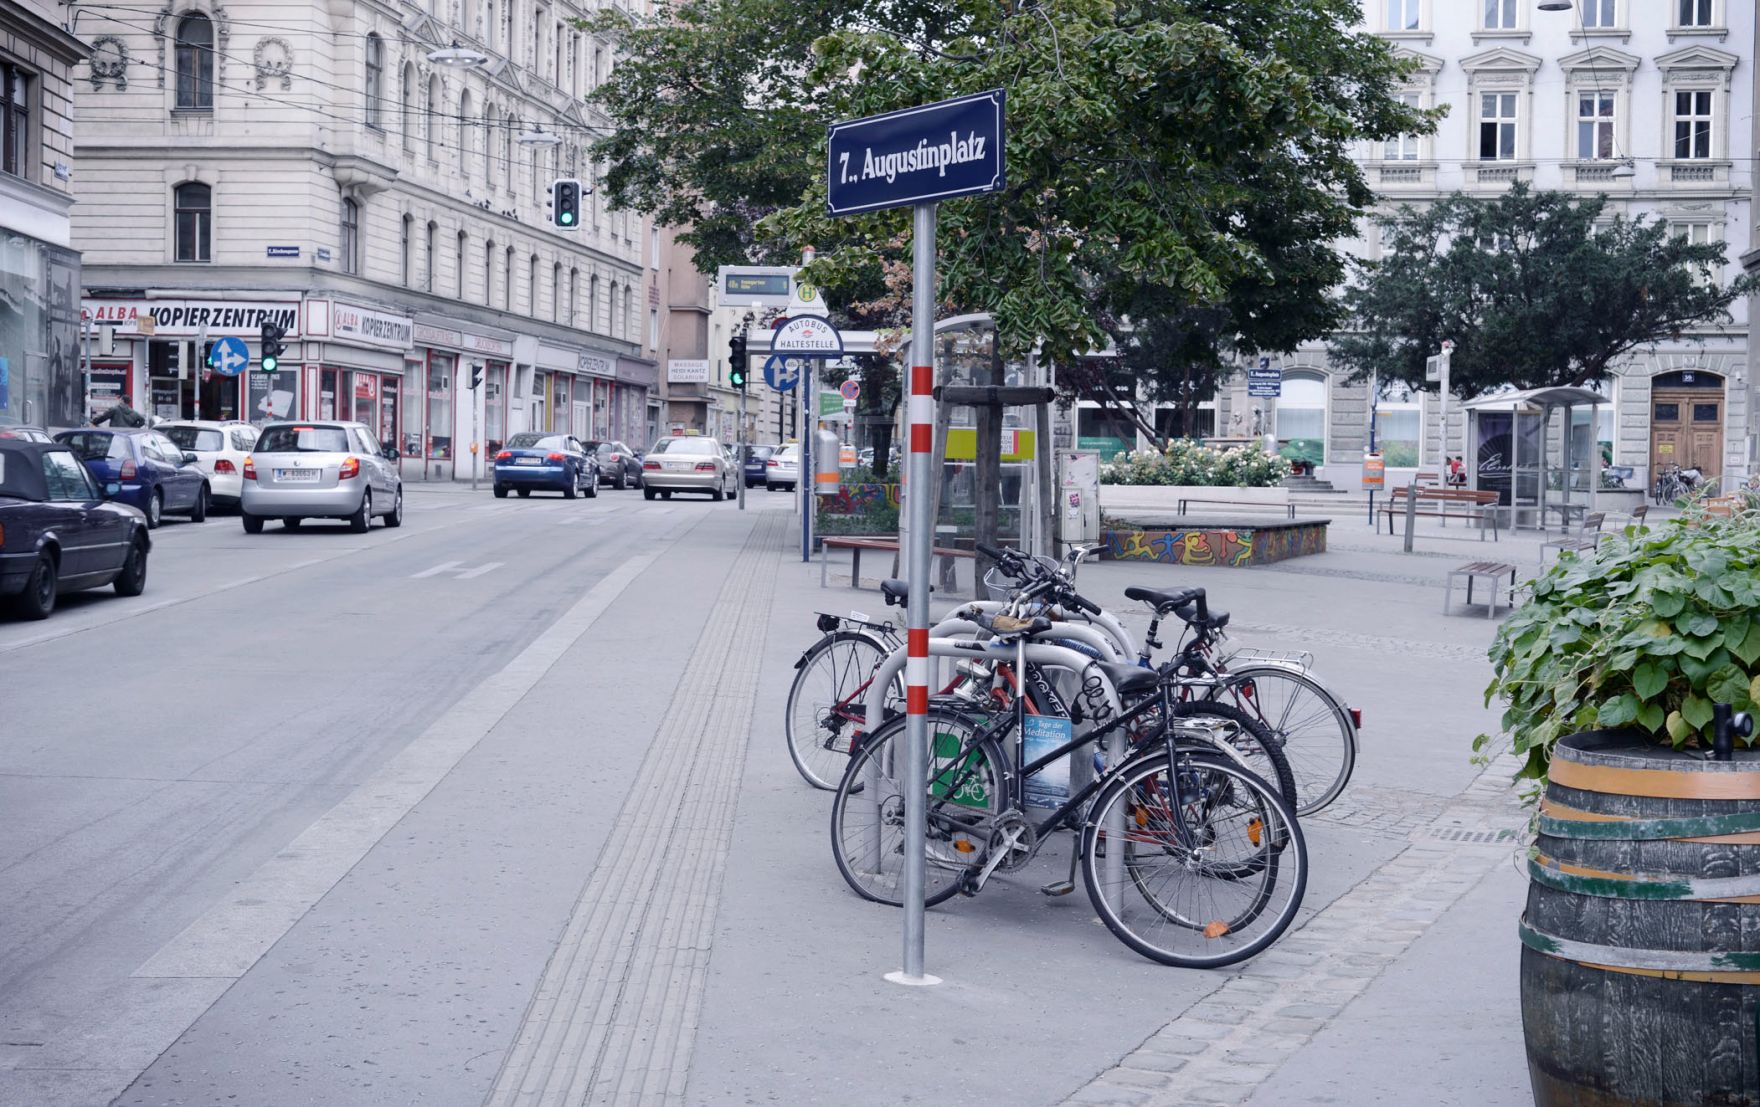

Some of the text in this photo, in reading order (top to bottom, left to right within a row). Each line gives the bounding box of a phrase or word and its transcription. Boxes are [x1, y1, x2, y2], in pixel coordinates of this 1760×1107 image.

[839, 130, 985, 184] 7., Augustinplatz
[802, 288, 812, 299] H
[96, 306, 138, 320] ALBA
[149, 307, 296, 329] KOPIERZENTRUM
[361, 316, 411, 343] KOPIERZENTRUM
[788, 319, 828, 334] AUTOBUS
[780, 340, 834, 349] HALTESTELLE
[1038, 720, 1051, 729] Tage
[1024, 727, 1066, 739] Meditation
